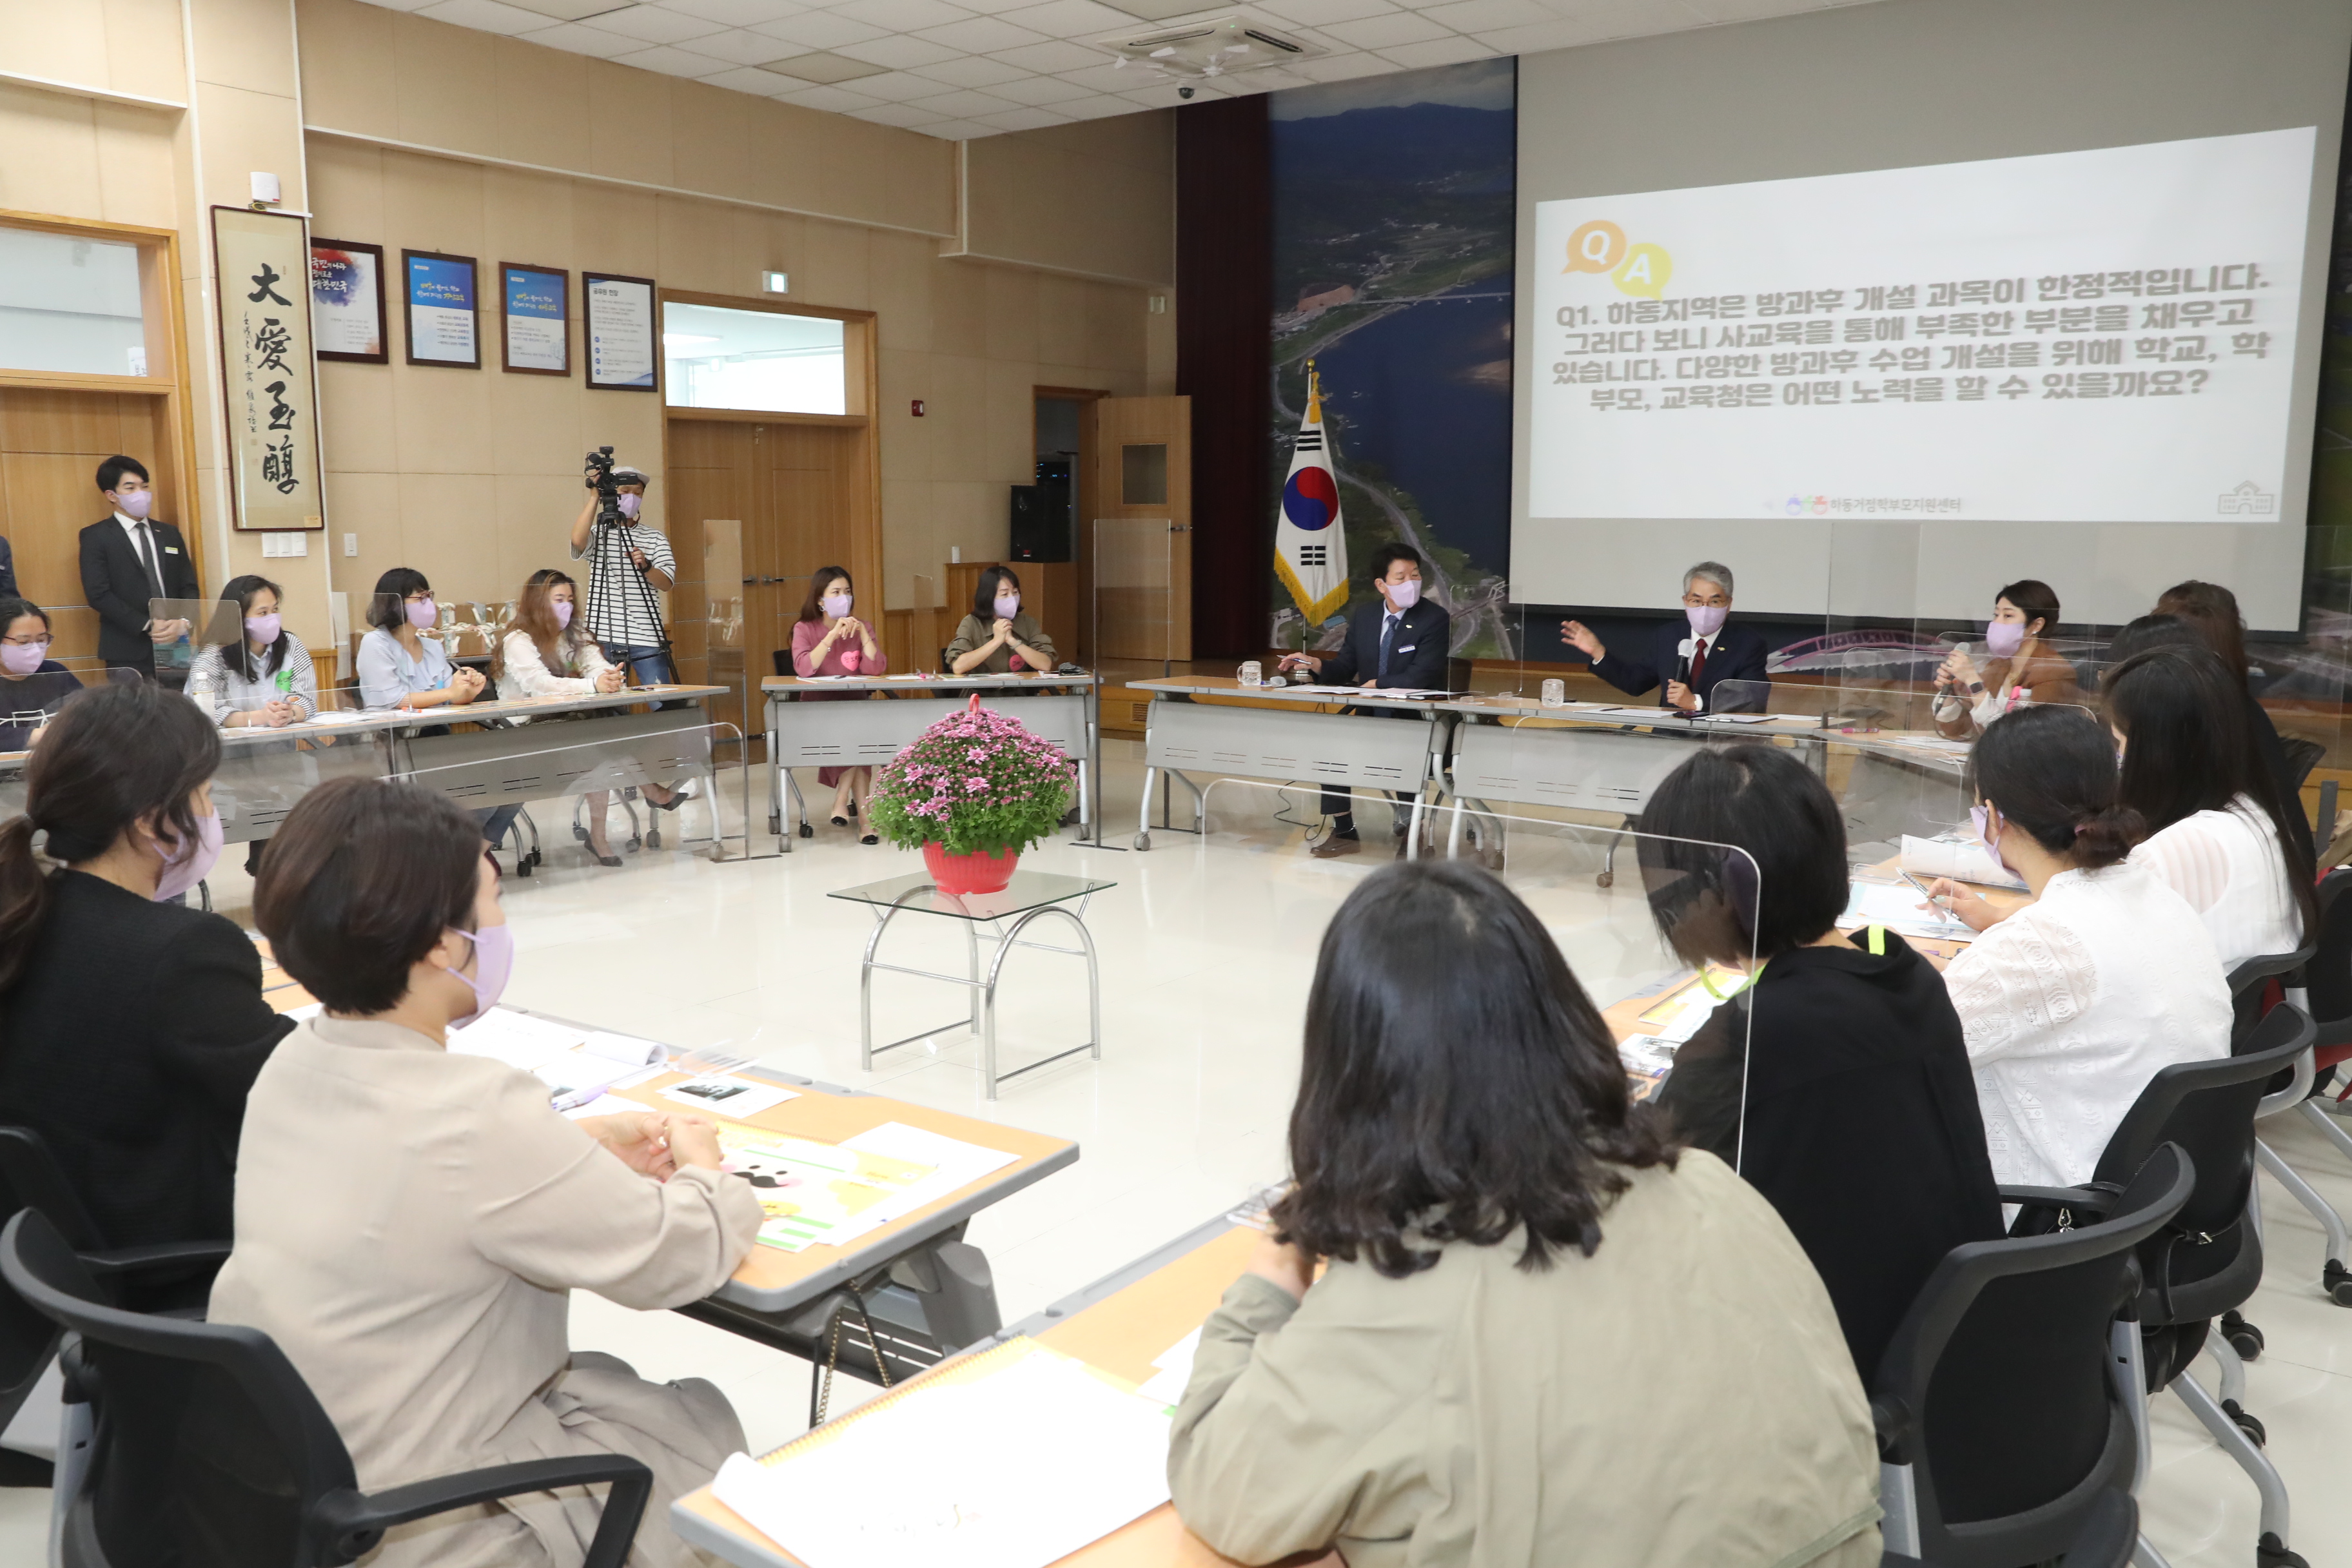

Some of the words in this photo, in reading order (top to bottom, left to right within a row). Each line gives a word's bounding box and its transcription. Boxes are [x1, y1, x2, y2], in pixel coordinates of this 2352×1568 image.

[1581, 230, 1611, 265] Q
[1623, 253, 1651, 284] A
[312, 279, 348, 293] 대한민국
[1557, 306, 1598, 328] Q1.
[1607, 295, 1745, 324] 하동지역은
[1756, 289, 1845, 317] 방과후
[1854, 284, 1916, 311] 개설
[1926, 278, 2025, 307] 과목이
[2037, 263, 2269, 301] 한정적입니다.
[1564, 330, 1645, 355] 그러다
[1653, 327, 1707, 351] 보니
[1716, 320, 1834, 348] 사교육을
[1843, 317, 1905, 342] 통해
[1915, 311, 2015, 339] 부족한
[2024, 305, 2129, 334] 부분을
[2141, 299, 2254, 329] 채우고
[1553, 358, 1667, 384] 있습니다.
[1676, 354, 1761, 379] 다양한
[1770, 349, 1858, 376] 방과후
[1868, 346, 1930, 372] 수업
[1941, 342, 2041, 369] 개설을
[2052, 338, 2122, 366] 위해
[2135, 336, 2217, 362] 학교,
[2231, 331, 2271, 358] 학
[1591, 389, 1651, 411] 부모,
[1660, 384, 1772, 409] 교육청은
[1783, 381, 1841, 405] 어떤
[1850, 377, 1945, 403] 노력을
[1955, 376, 1988, 401] 할
[1997, 375, 2030, 400] 수
[2042, 369, 2209, 399] 있을까요?
